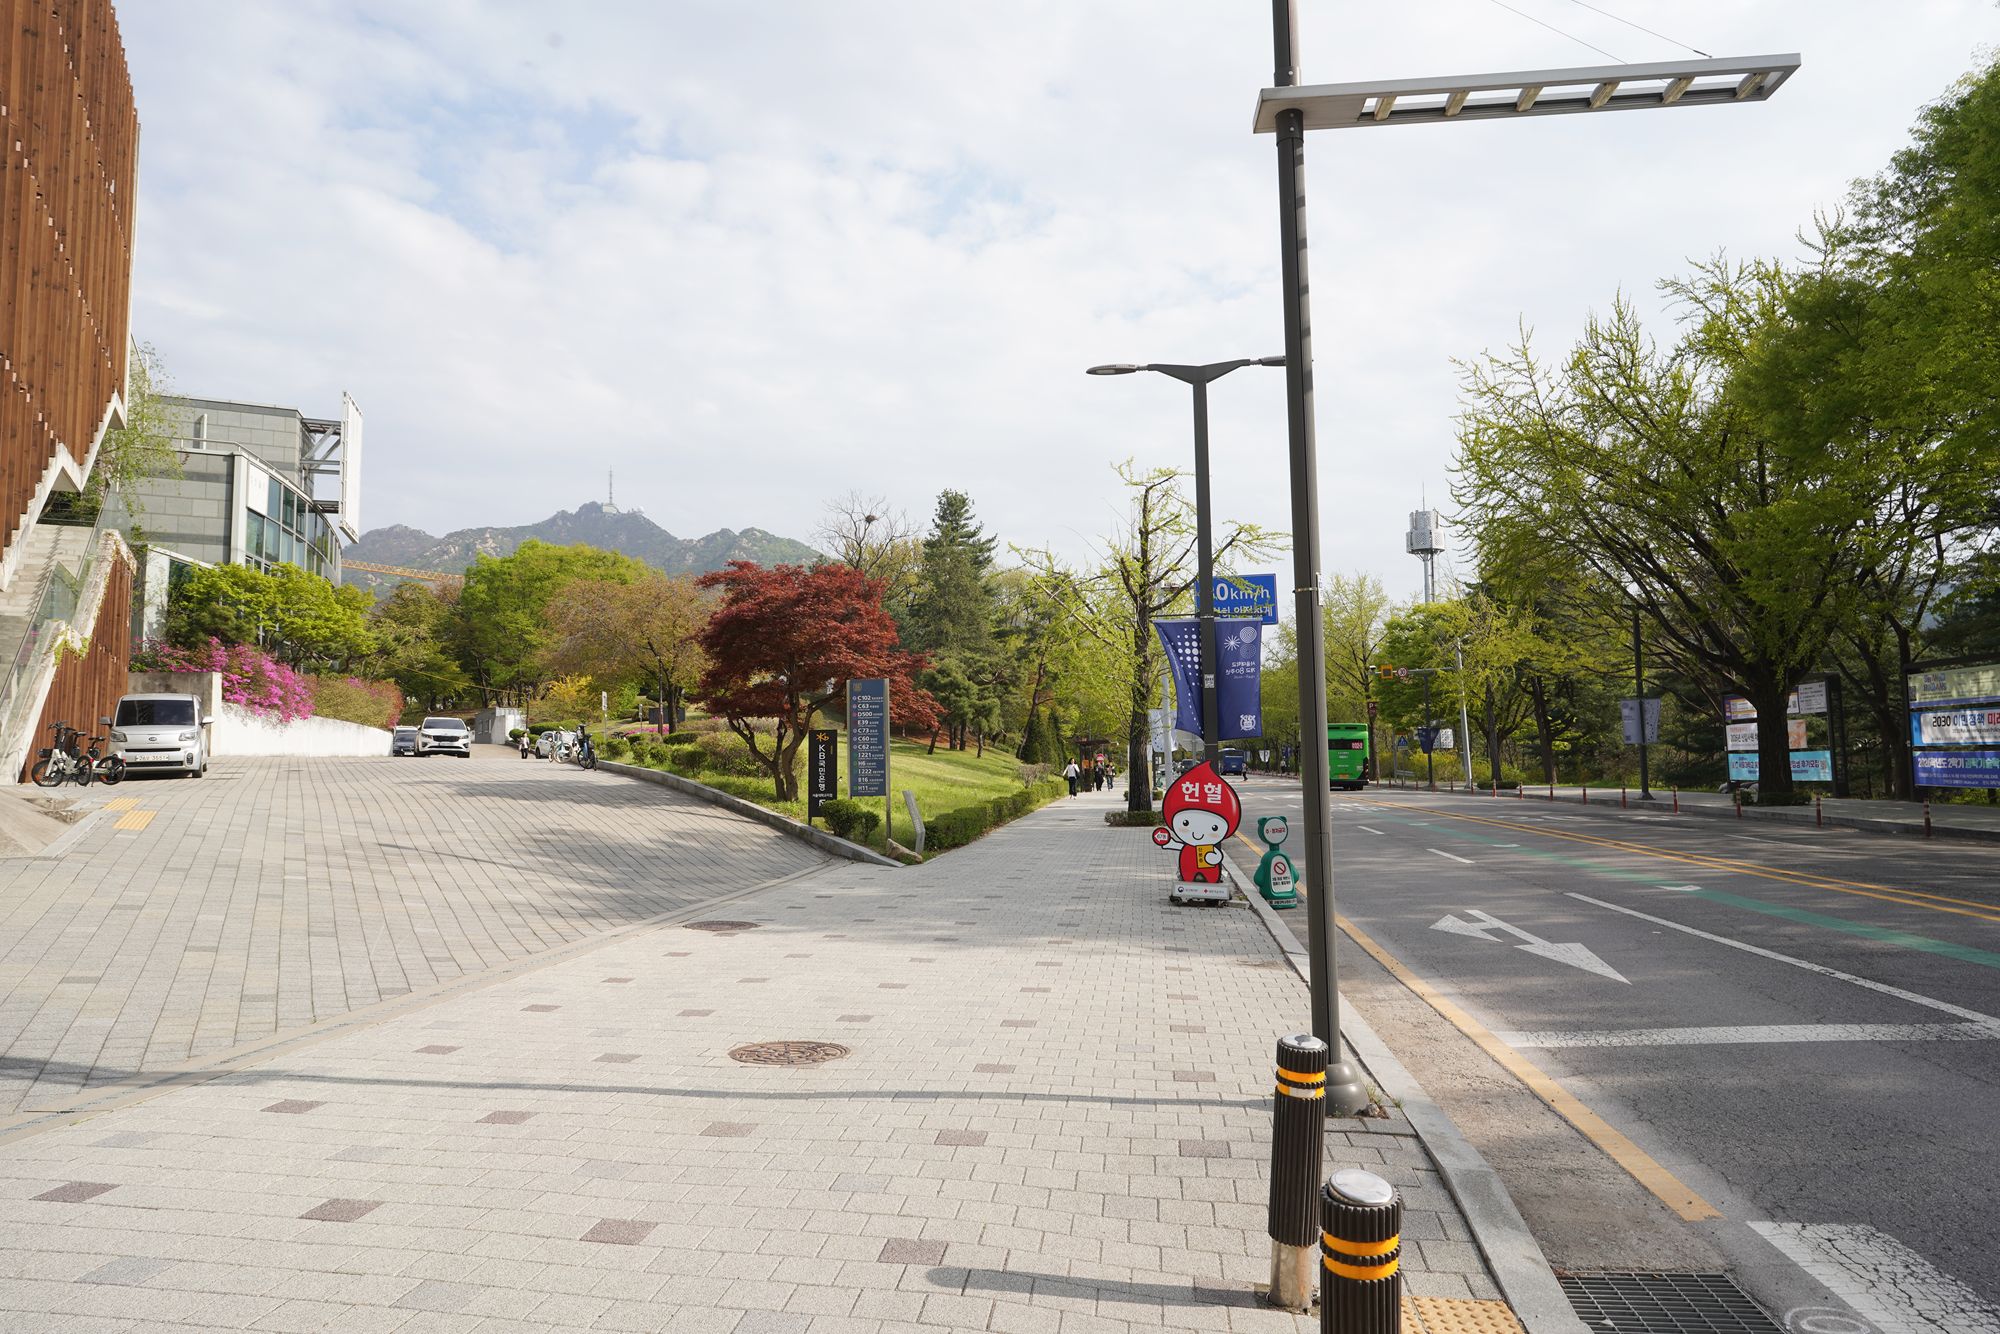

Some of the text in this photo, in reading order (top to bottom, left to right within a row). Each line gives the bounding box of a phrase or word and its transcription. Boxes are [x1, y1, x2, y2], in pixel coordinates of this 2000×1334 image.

[1932, 715, 1951, 727] 2030
[1953, 713, 1985, 726] 이민정책
[818, 744, 826, 792] KB국민은행
[1181, 781, 1222, 804] 헌혈
